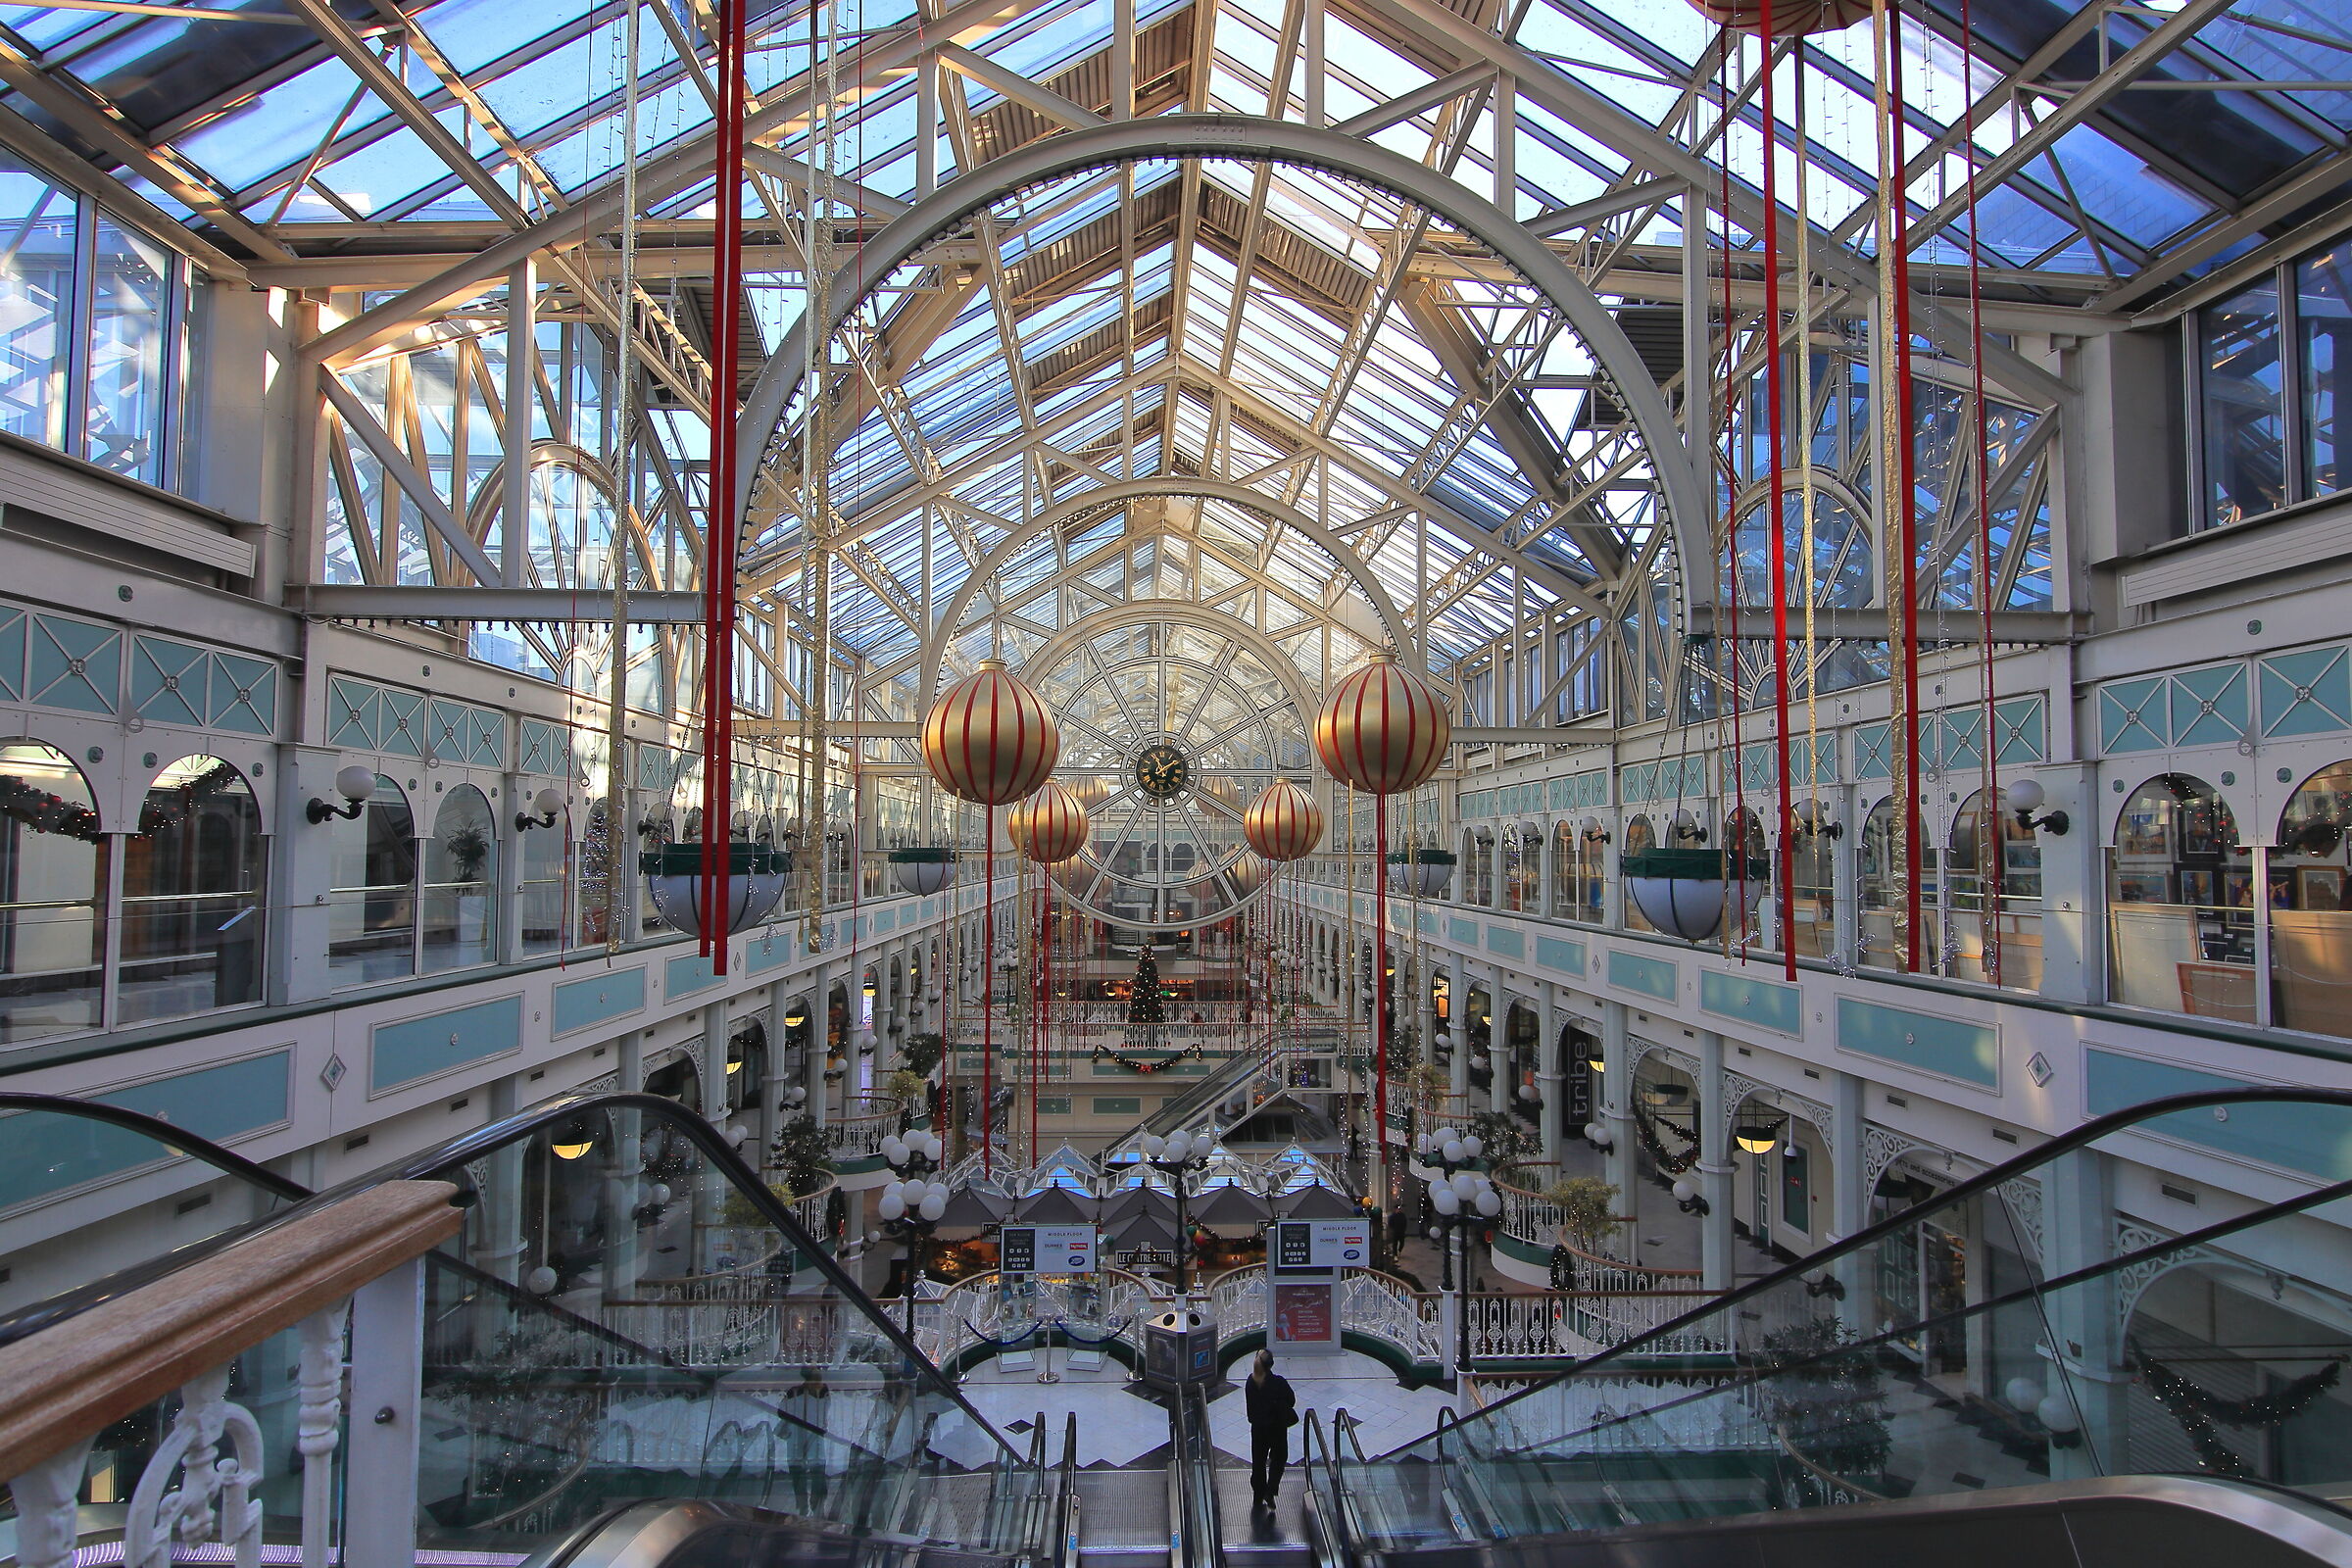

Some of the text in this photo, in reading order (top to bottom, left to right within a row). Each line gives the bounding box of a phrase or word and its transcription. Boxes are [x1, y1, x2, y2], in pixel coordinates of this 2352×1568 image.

[1570, 1042, 1588, 1116] tribe
[1118, 1253, 1126, 1263] LE
[1127, 1253, 1152, 1263] CTRE
